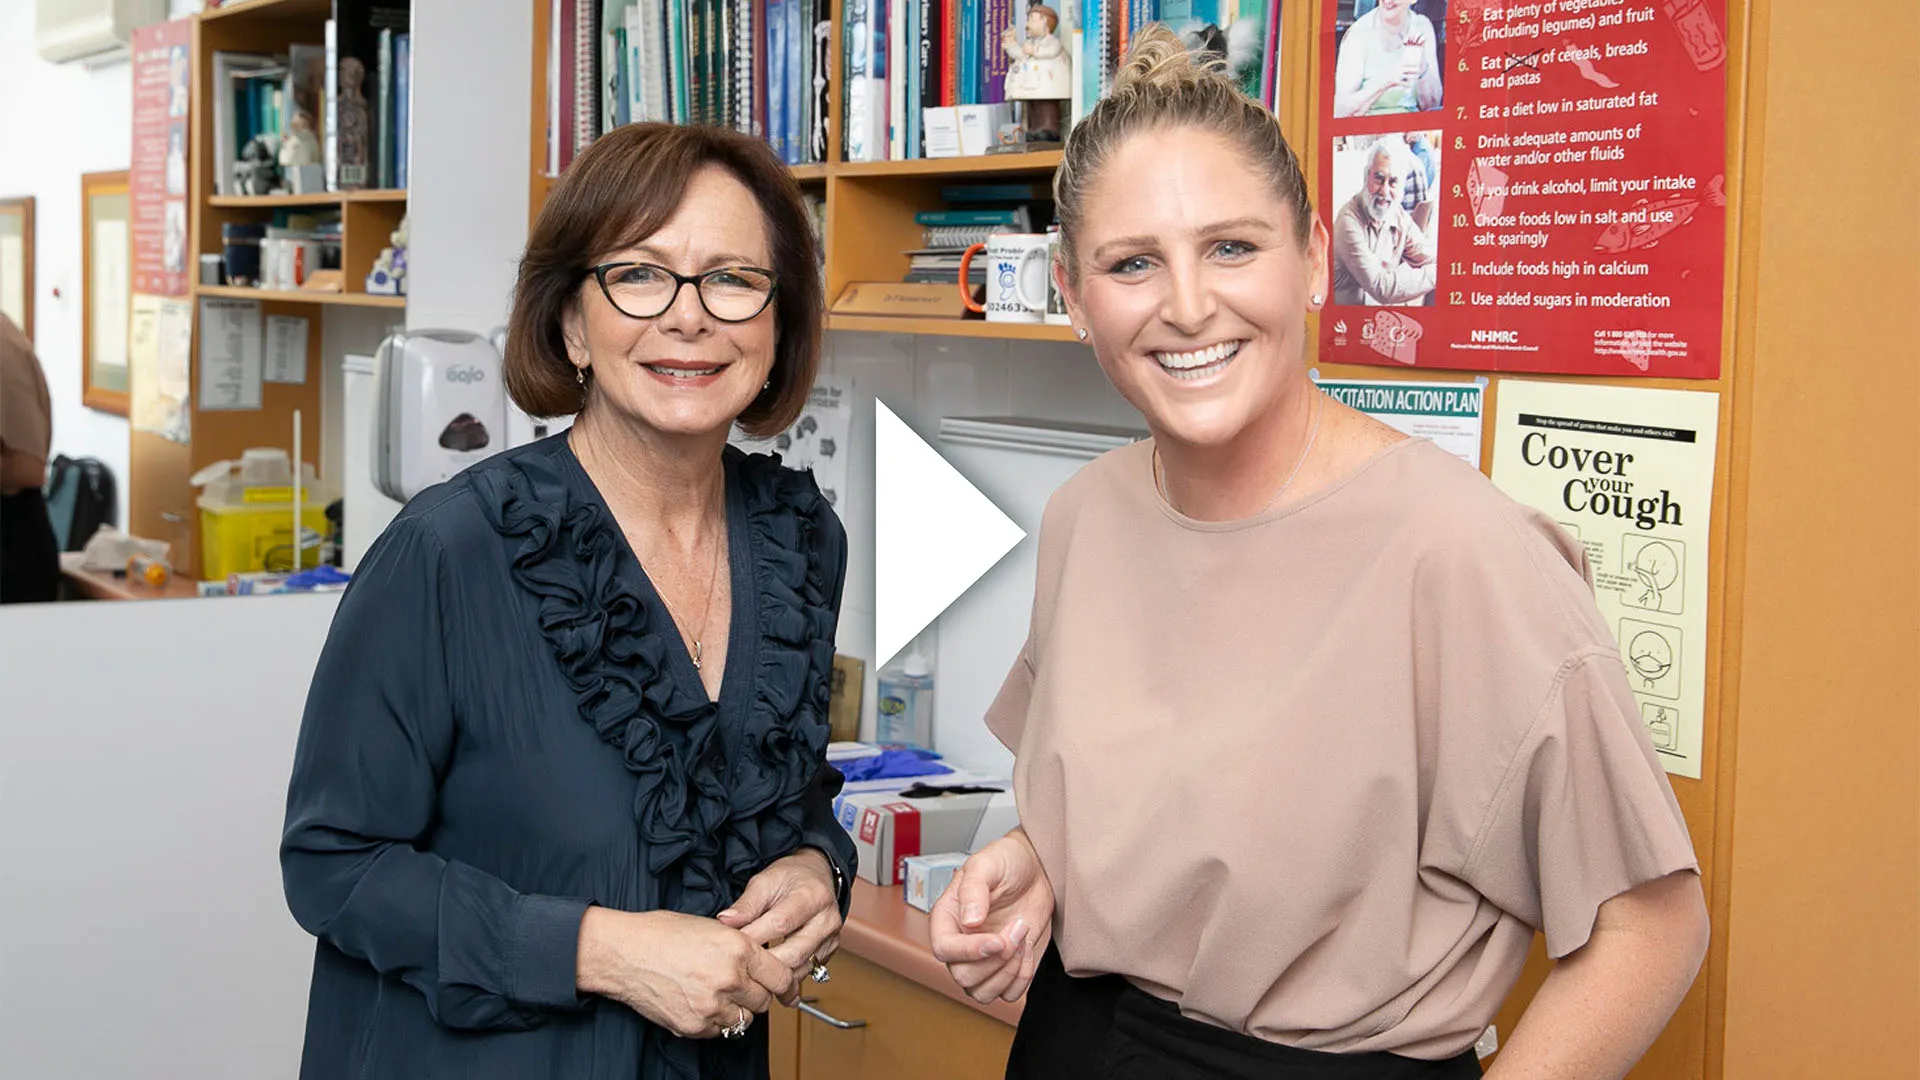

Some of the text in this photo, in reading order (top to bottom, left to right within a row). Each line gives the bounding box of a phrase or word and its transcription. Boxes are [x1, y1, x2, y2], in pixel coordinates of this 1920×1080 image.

[920, 0, 930, 35] rimary
[1459, 11, 1471, 24] 5.
[1483, 7, 1503, 21] Eat
[1506, 2, 1541, 22] plenty
[1543, 1, 1556, 14] of
[1482, 7, 1655, 40] (including legumes) and fruit
[921, 39, 931, 68] Care
[1458, 59, 1469, 72] 6.
[1481, 56, 1502, 70] Eat
[1541, 49, 1556, 63] of
[1558, 45, 1602, 63] cereals,
[1605, 40, 1648, 57] breads
[1480, 72, 1541, 90] and pastas
[1456, 91, 1658, 120] 7. Eat a diet low in saturated fat
[1454, 124, 1642, 152] 8. Drink adequate amounts of
[1476, 145, 1625, 168] water and/or other fluids
[1452, 174, 1696, 200] 9. If you drink alcohol, limit your intake
[1452, 208, 1673, 228] 10. Choose foods low in salt and use
[1473, 230, 1549, 248] salt sparingly
[1450, 260, 1649, 279] 11. Include foods high in calcium
[1449, 291, 1670, 310] 12. Use added sugars in moderation
[1471, 330, 1518, 343] NHMRC
[1395, 389, 1442, 412] ACTION
[1445, 391, 1480, 413] PLAN
[1536, 417, 1547, 426] Stop
[1556, 420, 1574, 428] spread
[1580, 422, 1596, 430] germs
[1644, 428, 1662, 436] others
[1522, 432, 1634, 477] Cover
[1587, 477, 1634, 494] your
[1563, 478, 1683, 530] Cough
